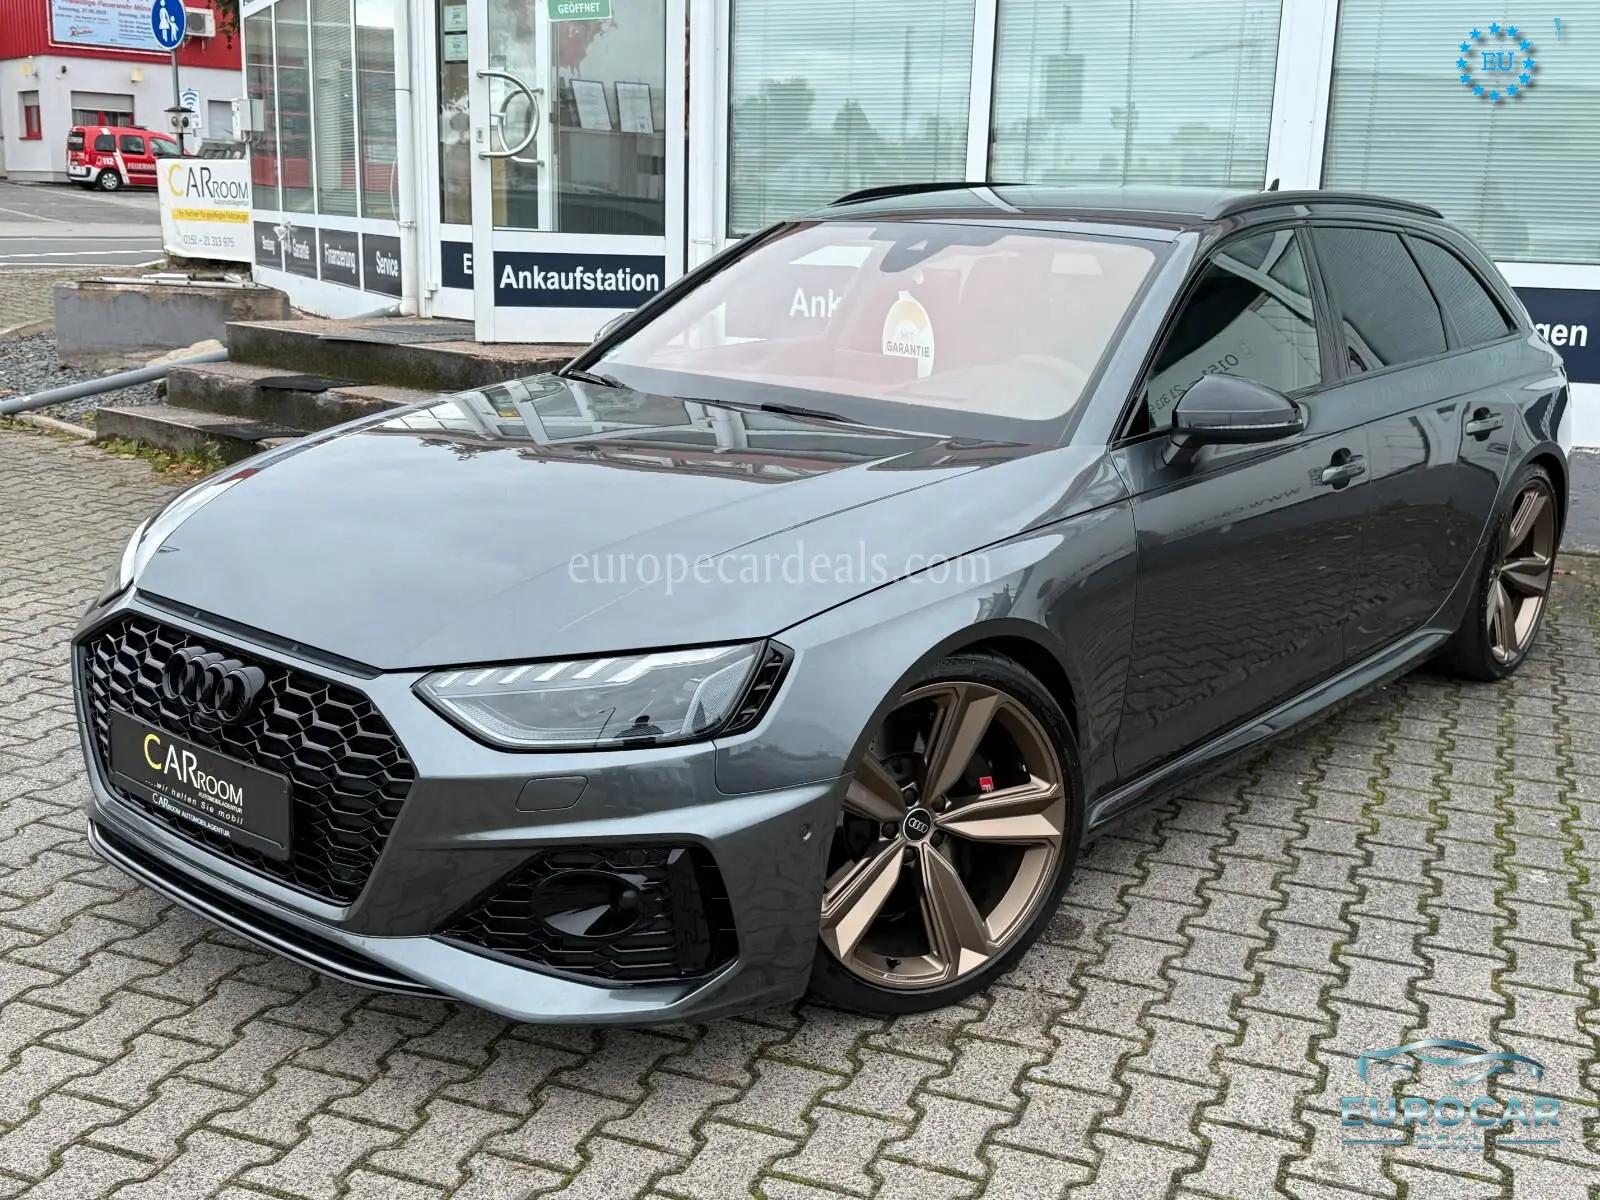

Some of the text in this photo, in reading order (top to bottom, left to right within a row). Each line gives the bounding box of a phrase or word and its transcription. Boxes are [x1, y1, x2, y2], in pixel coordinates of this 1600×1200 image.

[558, 2, 601, 14] GEÖFFNET
[102, 157, 115, 166] 112
[324, 243, 356, 275] Finanzierung
[376, 251, 399, 277] Service
[500, 265, 660, 291] Ankaufstation
[886, 341, 930, 358] GARANTIE
[171, 788, 197, 806] halten
[200, 801, 214, 813] Sie
[218, 810, 243, 825] mobil
